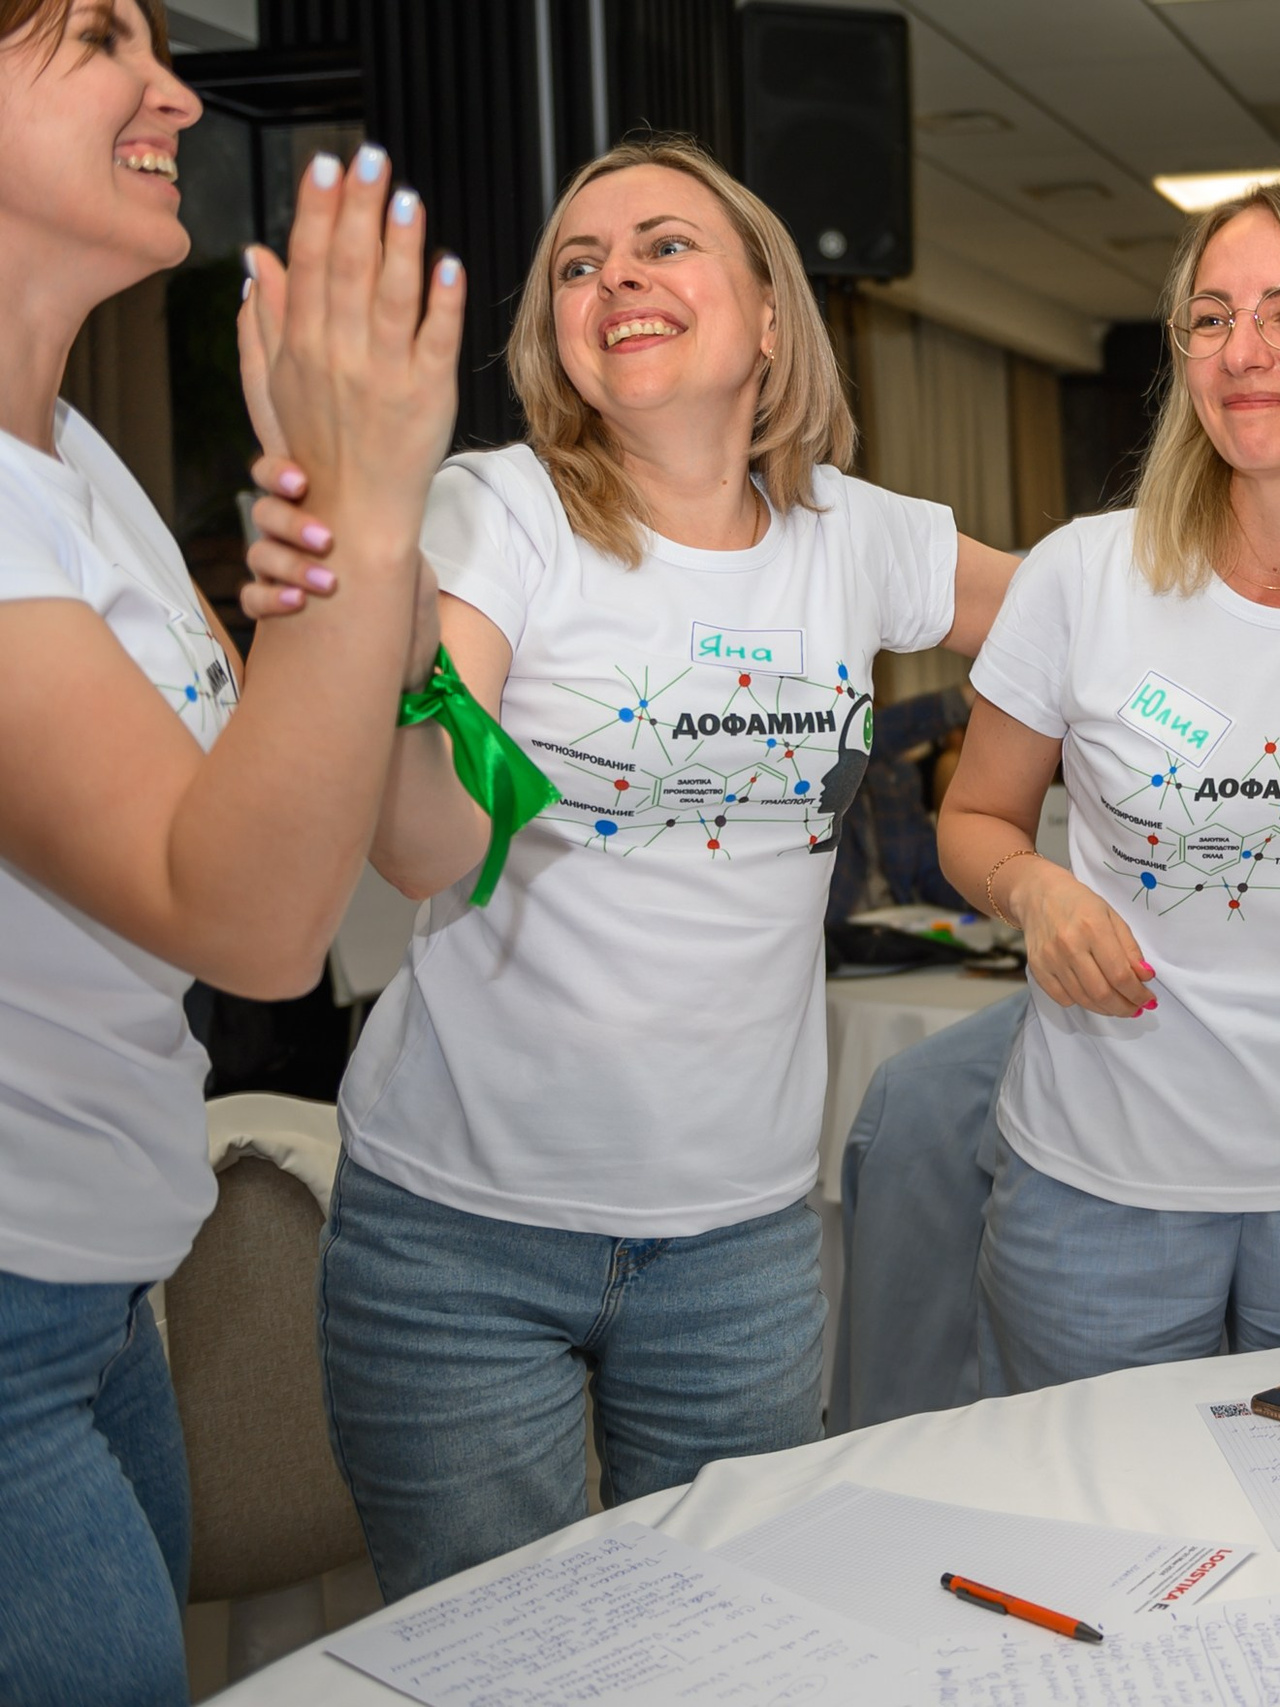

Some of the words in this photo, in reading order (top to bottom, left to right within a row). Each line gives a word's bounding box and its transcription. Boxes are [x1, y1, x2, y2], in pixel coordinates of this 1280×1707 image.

[699, 634, 773, 663] Яна
[672, 710, 836, 739] ДОФАМИН
[1131, 684, 1209, 749] Юлия
[531, 739, 636, 772] ПРОГНОЗИРОВАНИЕ
[663, 788, 723, 796] ПРОИЗВОДСТВО
[677, 778, 712, 786] ЗАКУПКА
[760, 797, 814, 806] ТРАНСПОРТ
[1187, 844, 1240, 852] ПРОИЗВОДСТВО
[1162, 1548, 1233, 1601] LOGISTIKA
